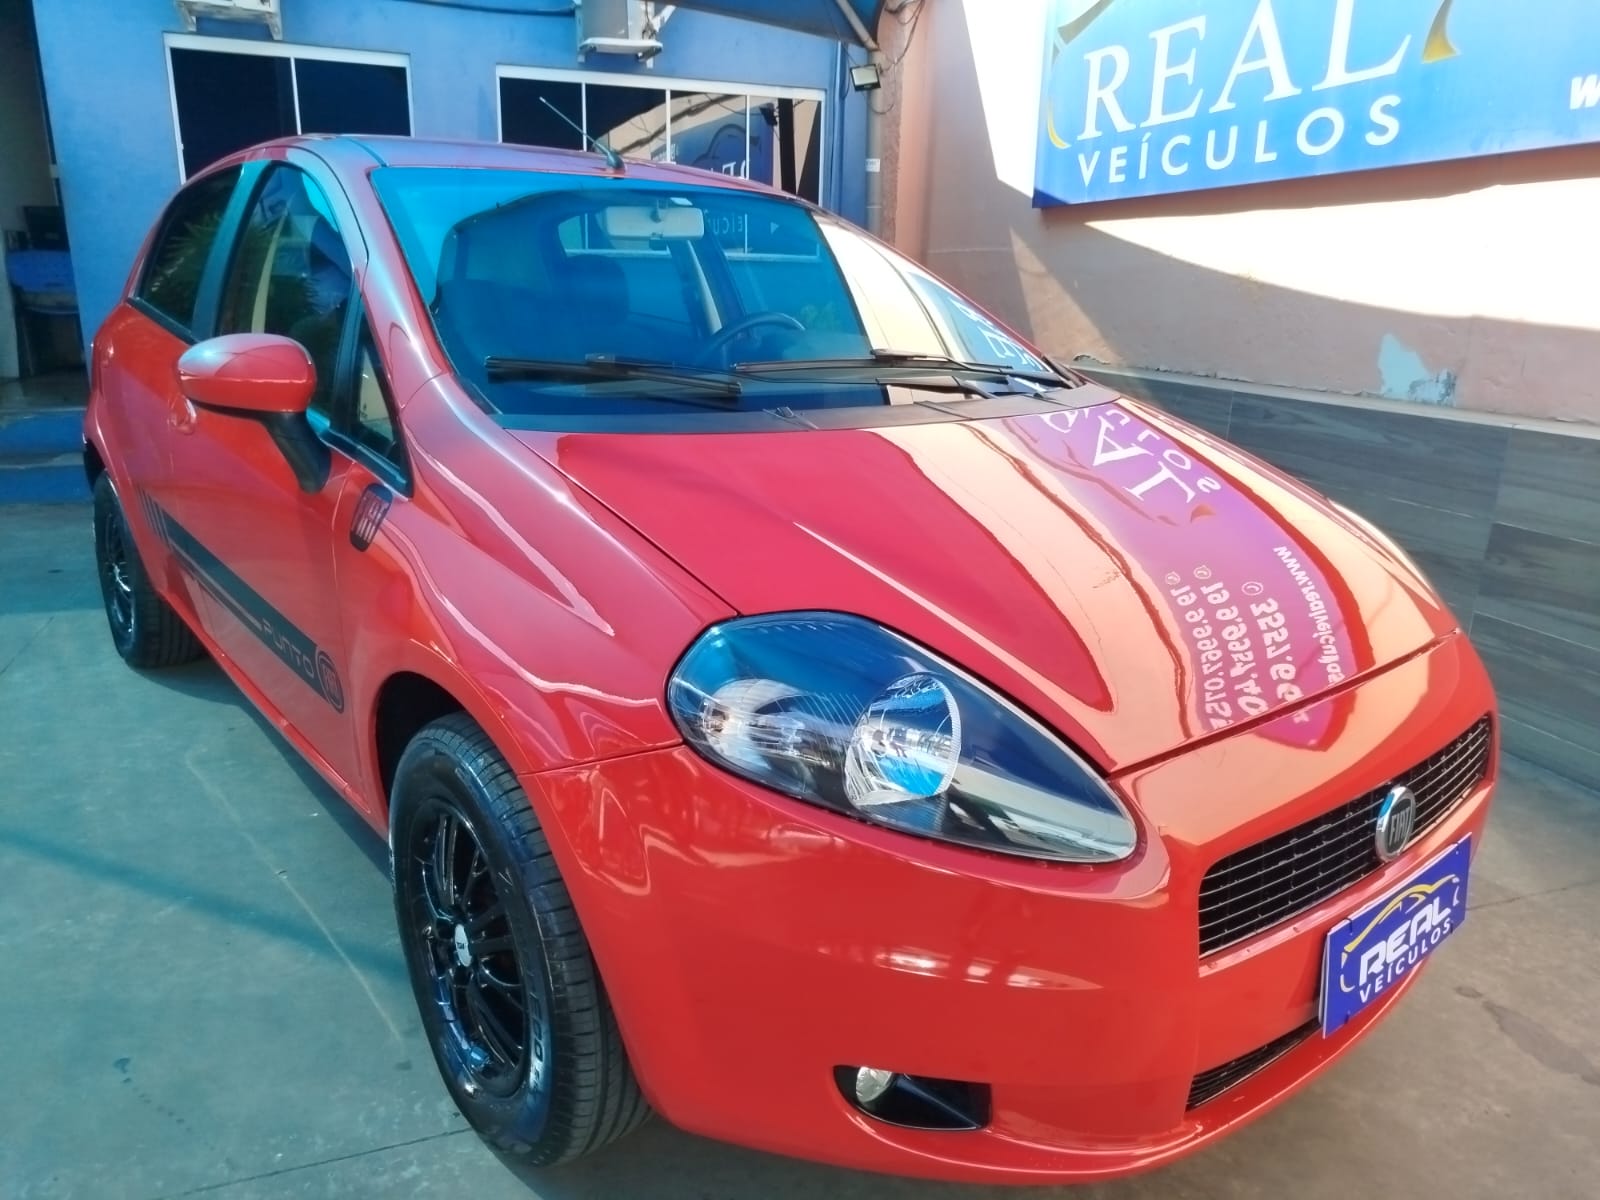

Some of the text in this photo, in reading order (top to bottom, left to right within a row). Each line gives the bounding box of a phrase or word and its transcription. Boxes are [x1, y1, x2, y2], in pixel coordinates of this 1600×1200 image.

[1077, 0, 1413, 142] REAL
[1077, 95, 1402, 187] VEÍCULOS
[1389, 806, 1412, 847] FIAT
[1358, 896, 1452, 987] REAL
[1359, 917, 1451, 1003] VEÍCULOS
